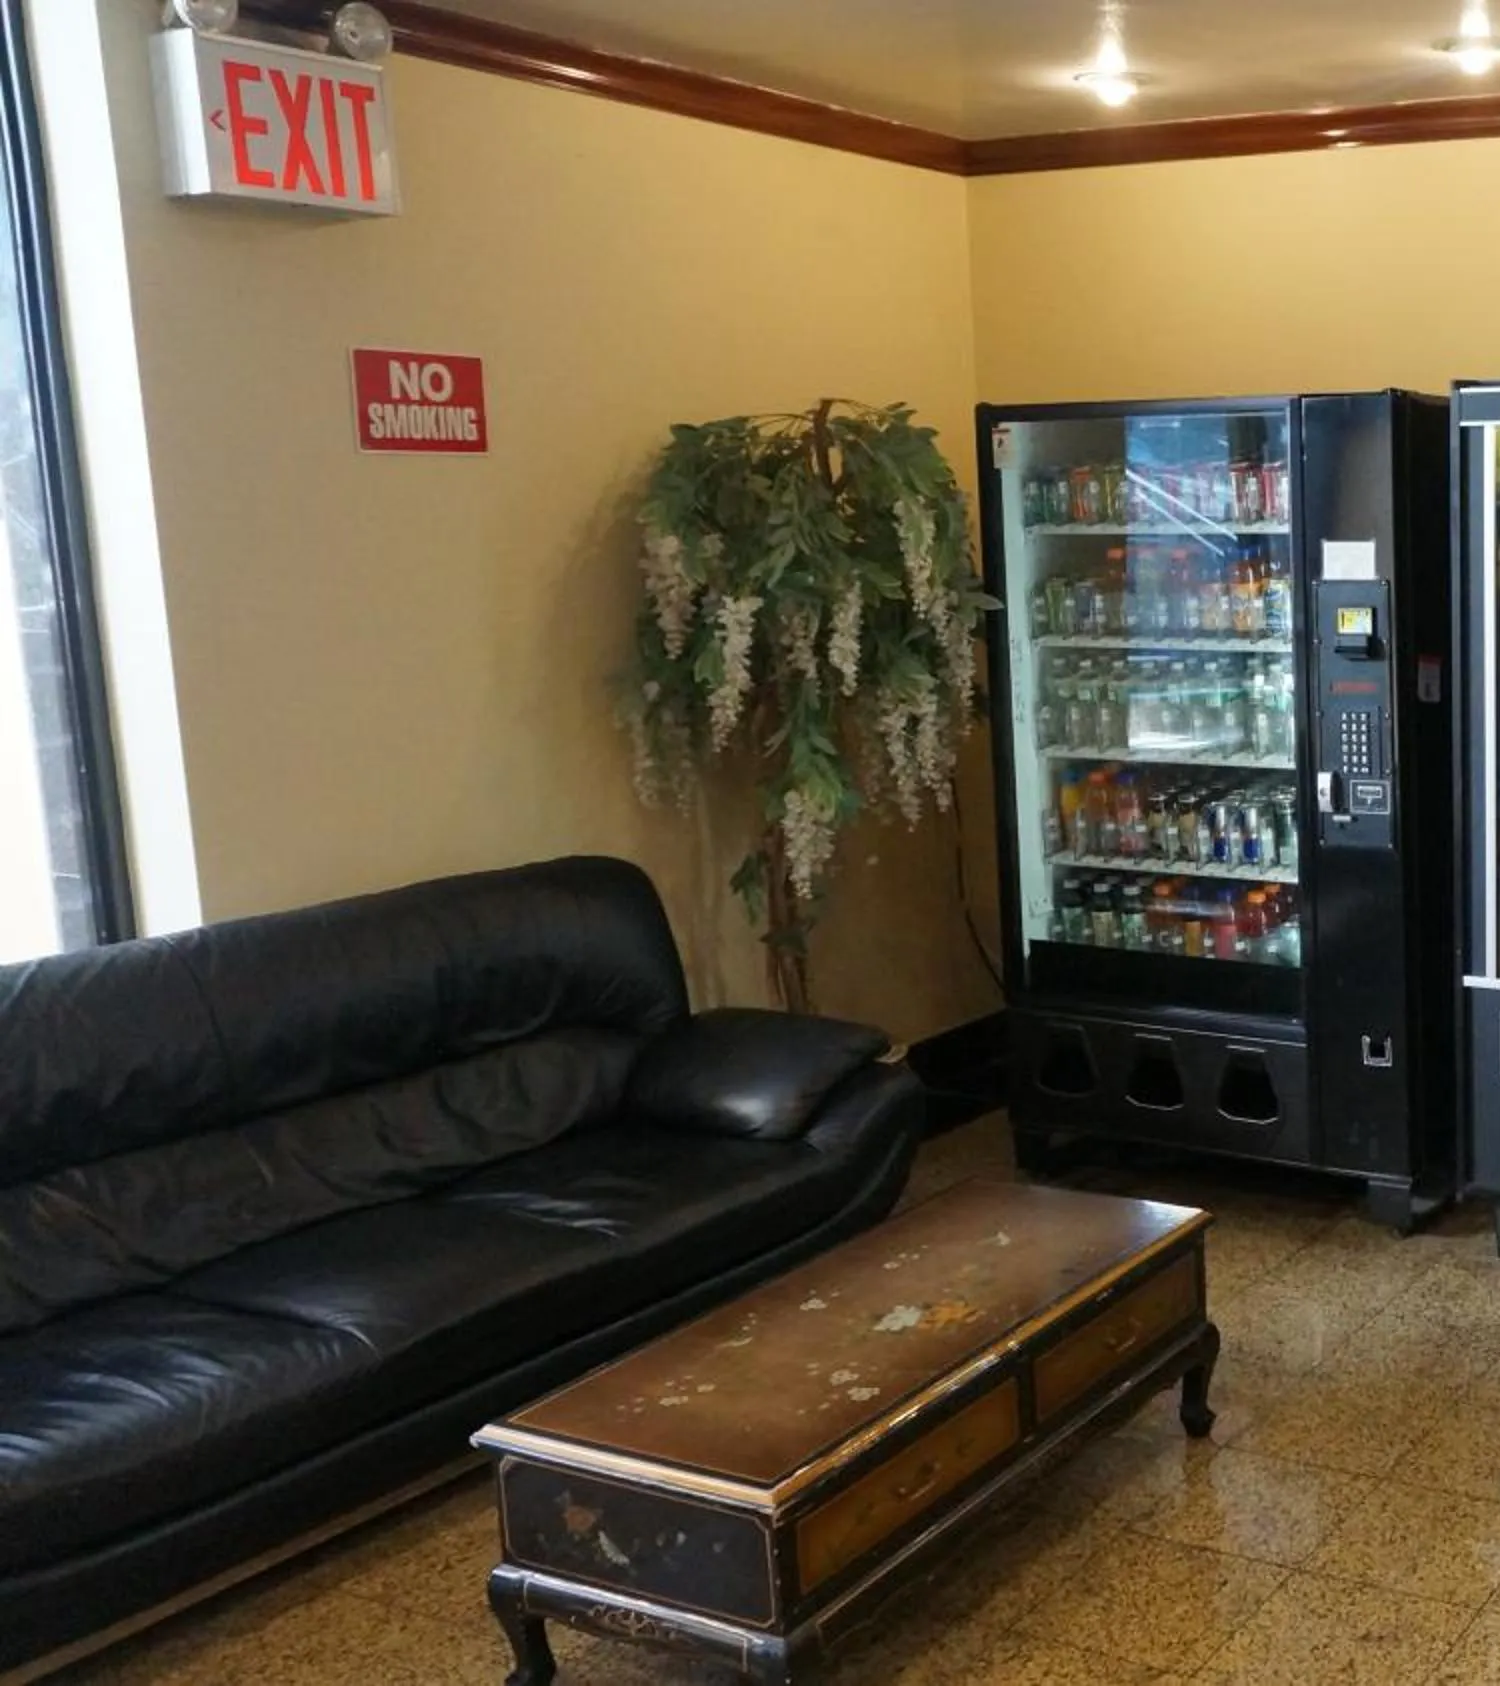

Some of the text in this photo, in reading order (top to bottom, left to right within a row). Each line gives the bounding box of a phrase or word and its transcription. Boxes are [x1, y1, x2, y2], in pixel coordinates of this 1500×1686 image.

[222, 60, 376, 201] EXIT
[388, 360, 454, 402] NO
[368, 403, 479, 441] SMOKING
